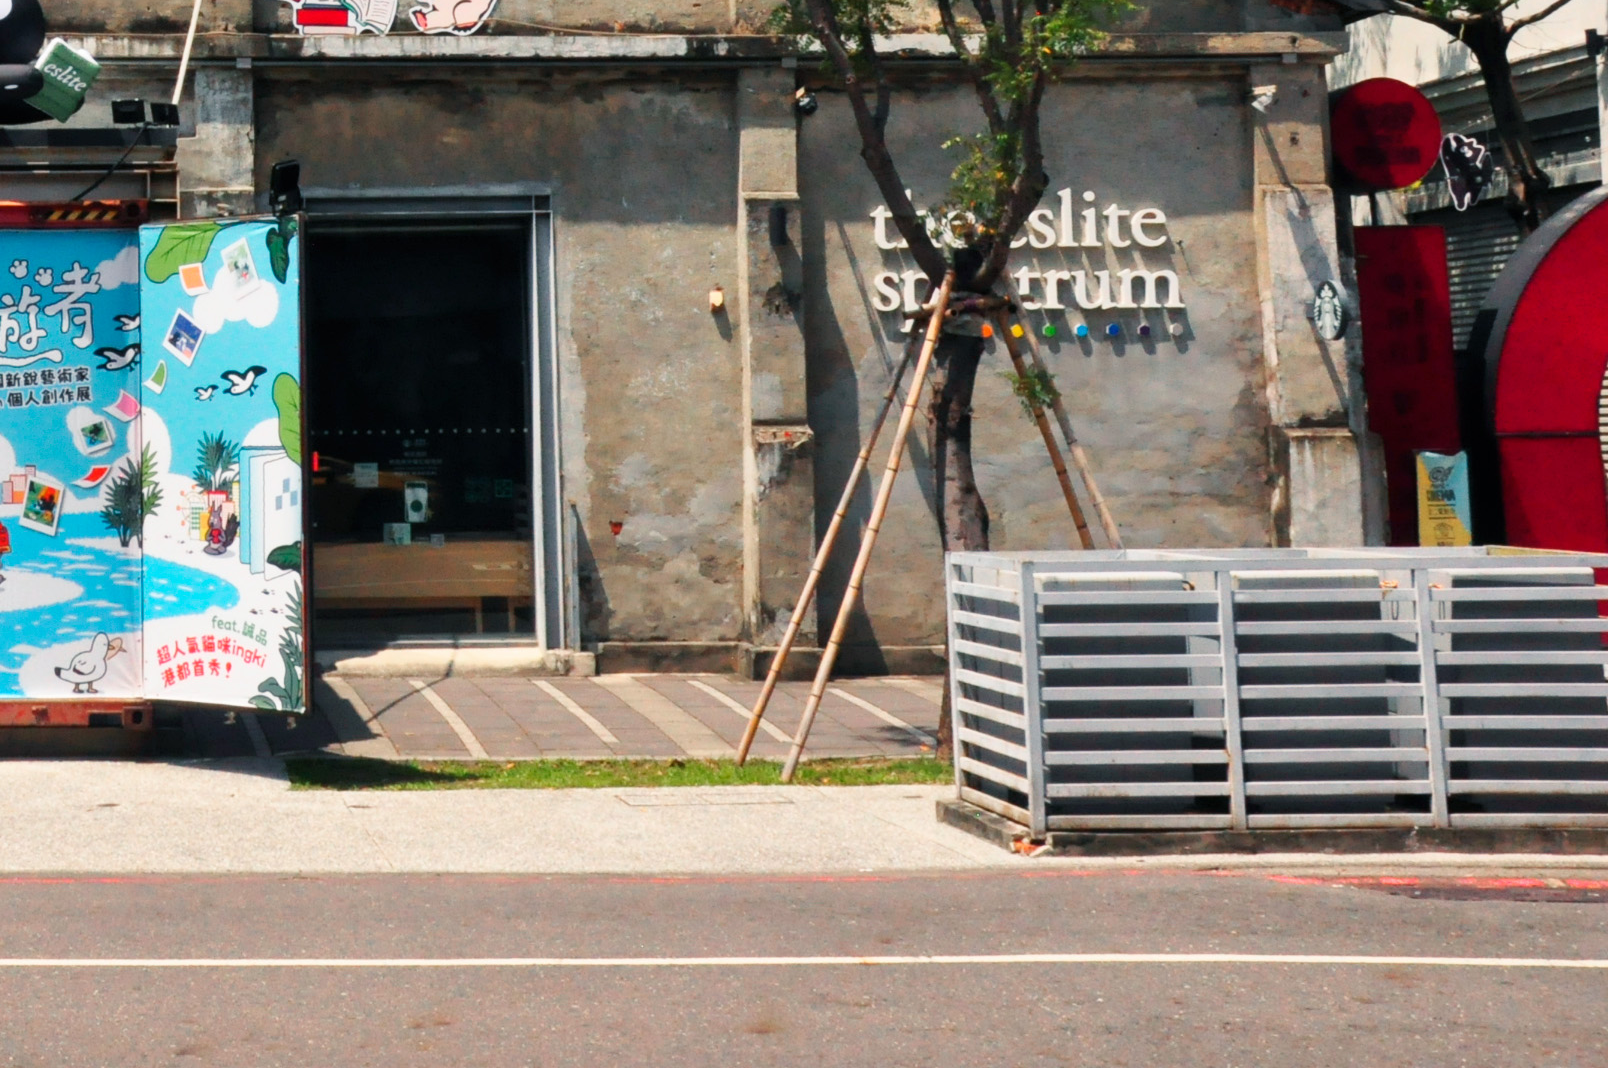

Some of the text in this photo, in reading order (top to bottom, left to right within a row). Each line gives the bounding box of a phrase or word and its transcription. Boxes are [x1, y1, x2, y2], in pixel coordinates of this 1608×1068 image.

[42, 62, 89, 93] eslite
[872, 266, 1186, 334] sptrum
[7, 386, 92, 407] 個人創作展
[211, 616, 268, 647] feat. 誠品
[157, 635, 268, 668] 超人氣貓咪ingki
[161, 659, 233, 689] 港都首秀!
